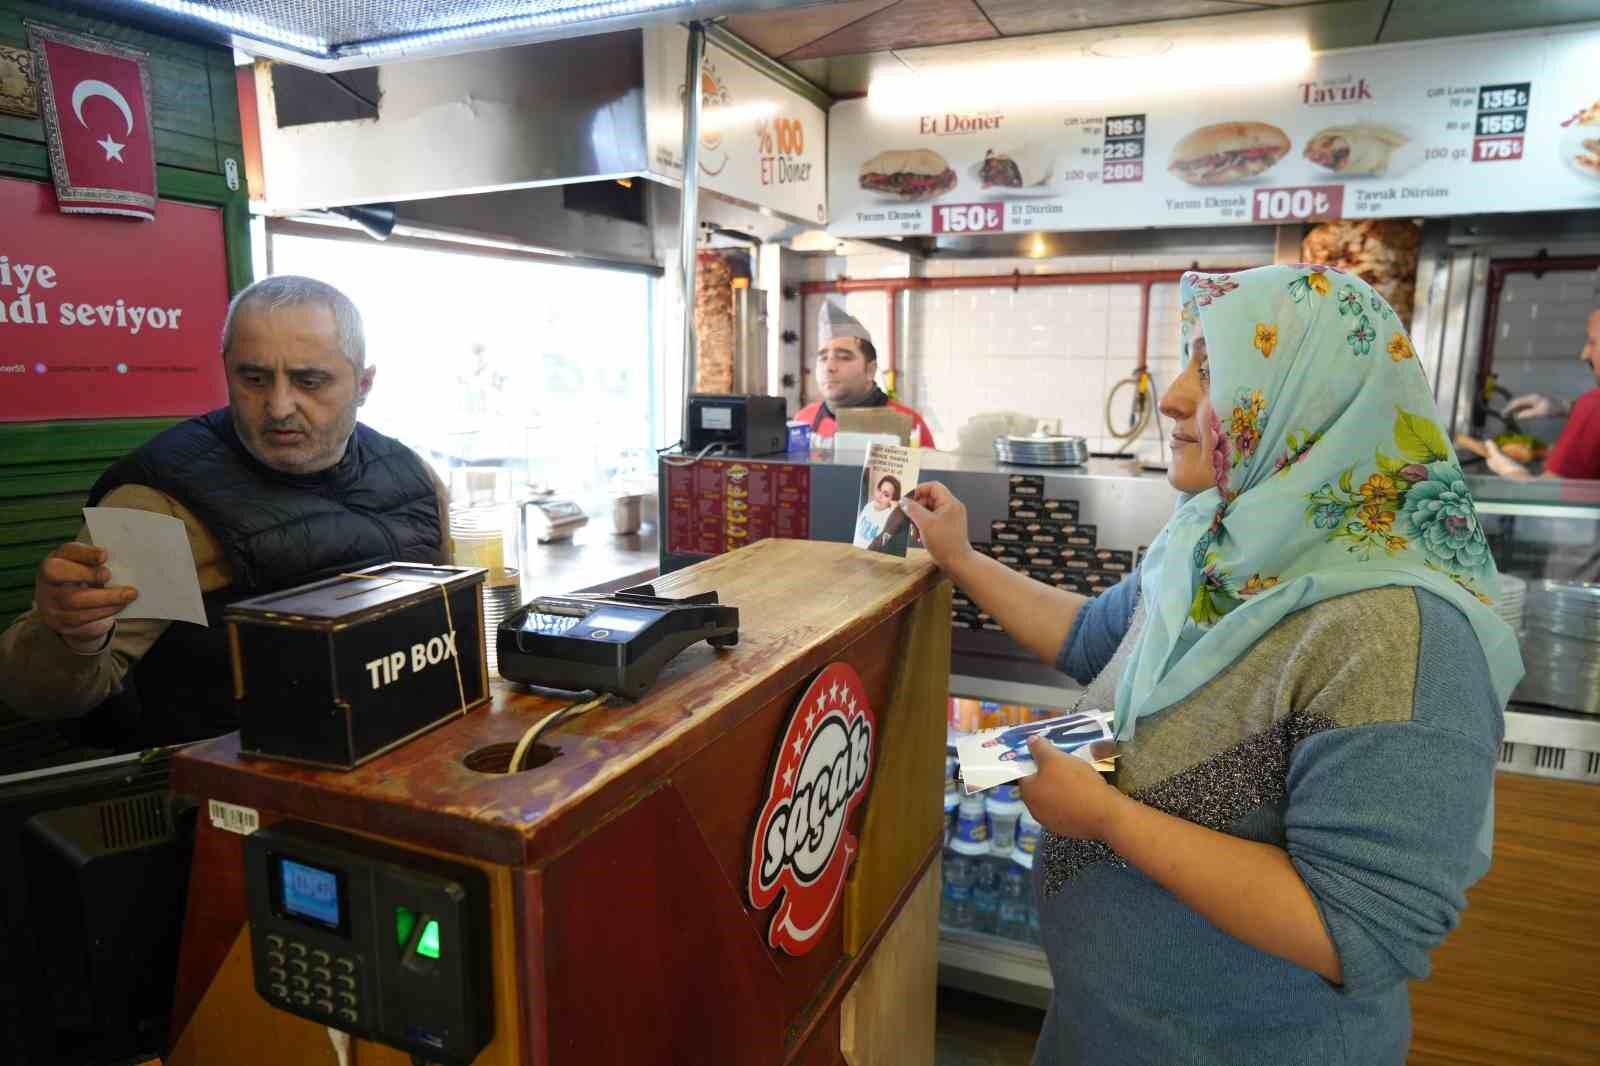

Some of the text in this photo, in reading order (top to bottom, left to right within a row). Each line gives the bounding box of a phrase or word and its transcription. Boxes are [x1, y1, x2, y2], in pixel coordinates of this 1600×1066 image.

[1297, 78, 1373, 105] Tavuk
[919, 116, 937, 135] Et
[759, 156, 776, 186] ET
[939, 204, 1000, 232] 150₺
[1256, 188, 1330, 220] 100₺
[59, 298, 183, 335] seviyor
[365, 629, 459, 690] TIP BOX
